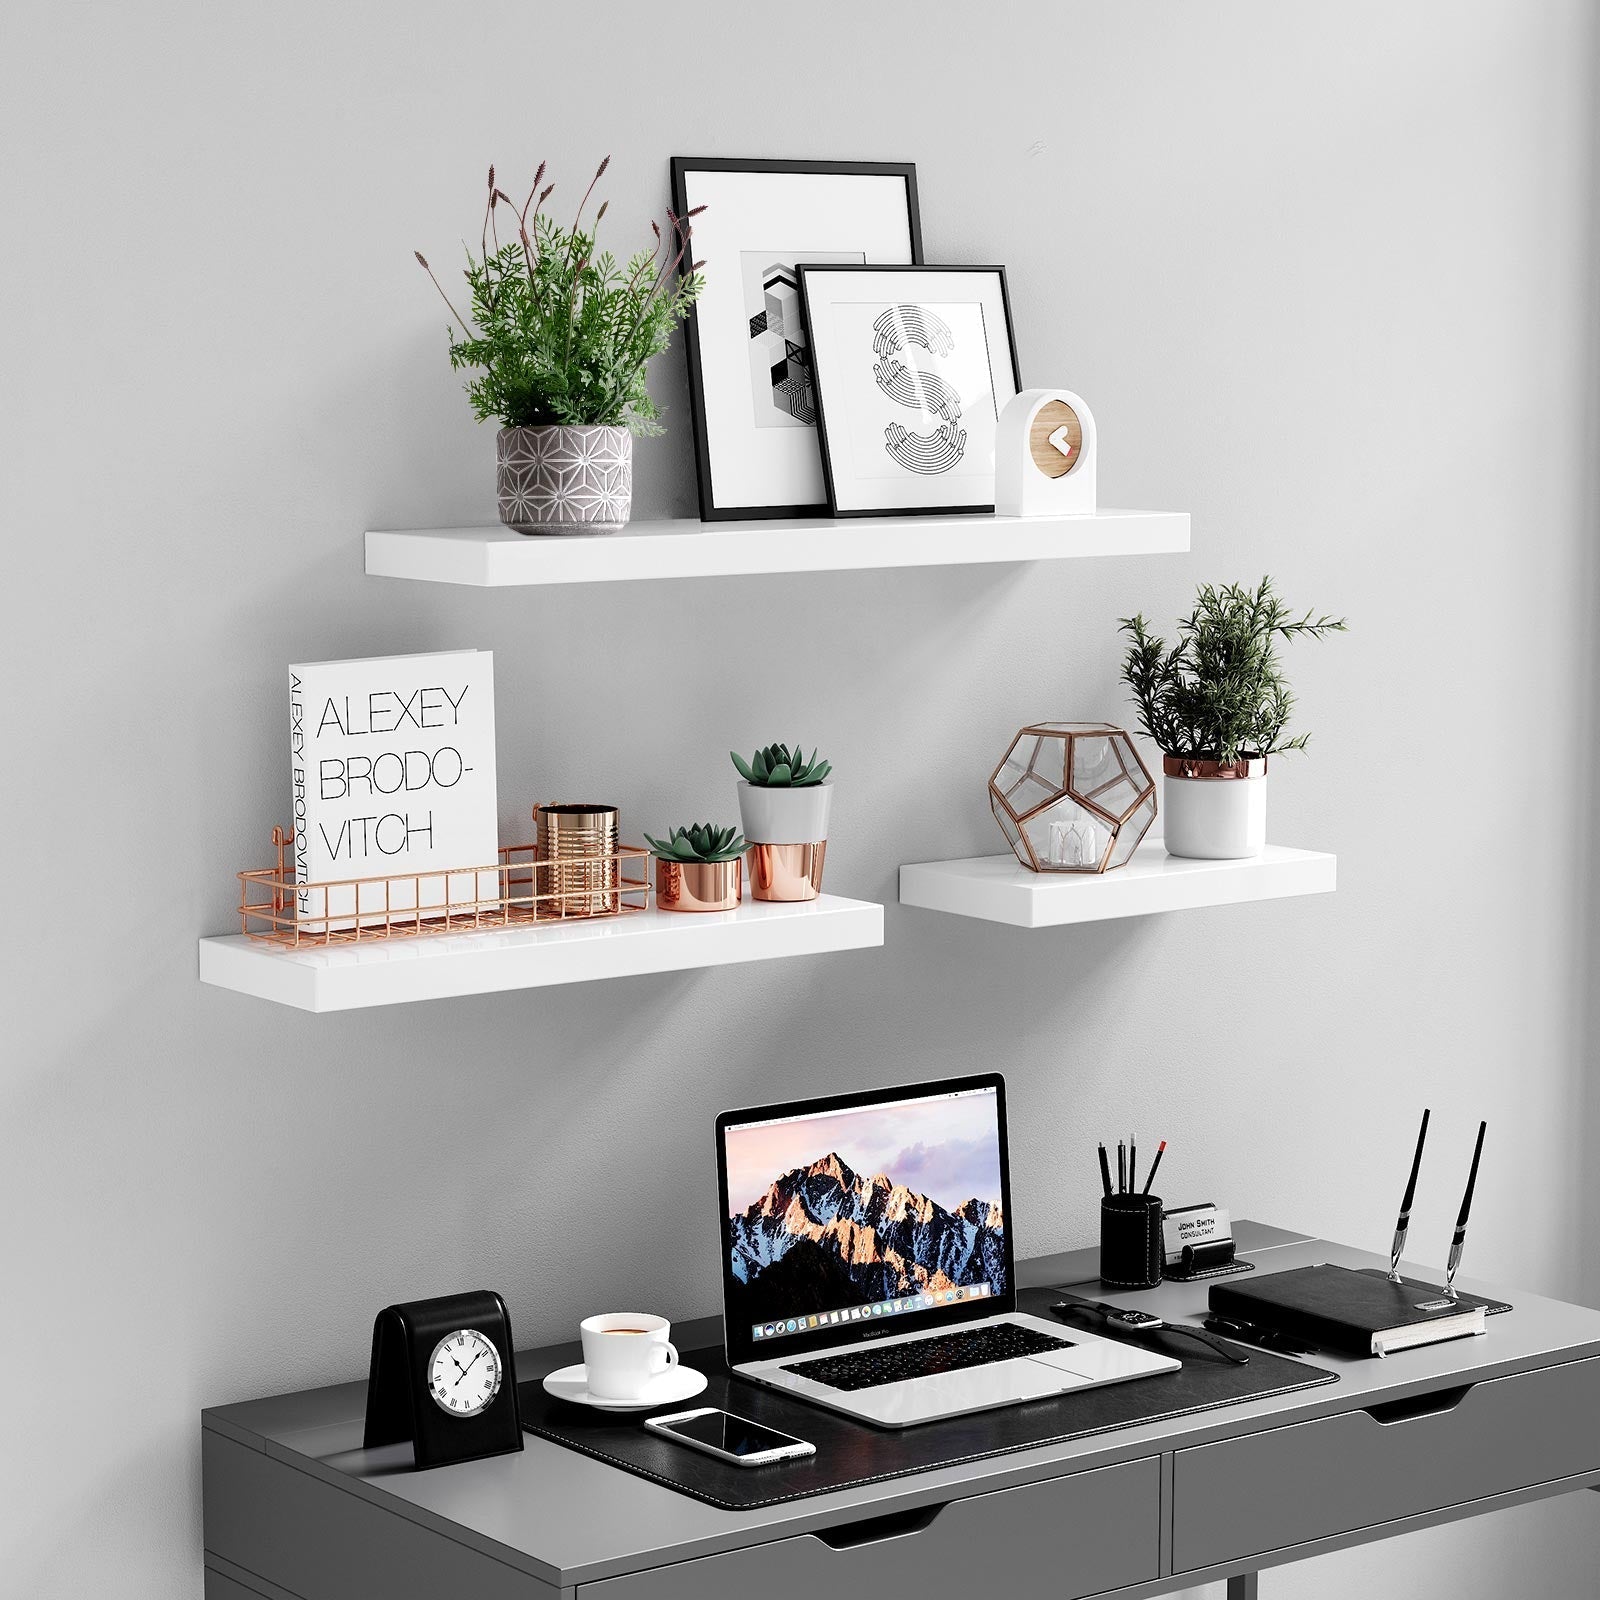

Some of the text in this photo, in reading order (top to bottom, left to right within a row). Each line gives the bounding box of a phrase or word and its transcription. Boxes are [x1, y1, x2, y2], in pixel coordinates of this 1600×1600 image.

[316, 684, 469, 738] ALEXEY
[291, 673, 309, 914] ALEXEY BRODOVITCH
[320, 746, 474, 800] BRODO-
[318, 810, 433, 860] VITCH
[1178, 1218, 1216, 1231] JOHN SMITH
[1180, 1227, 1215, 1240] CONSULTANT
